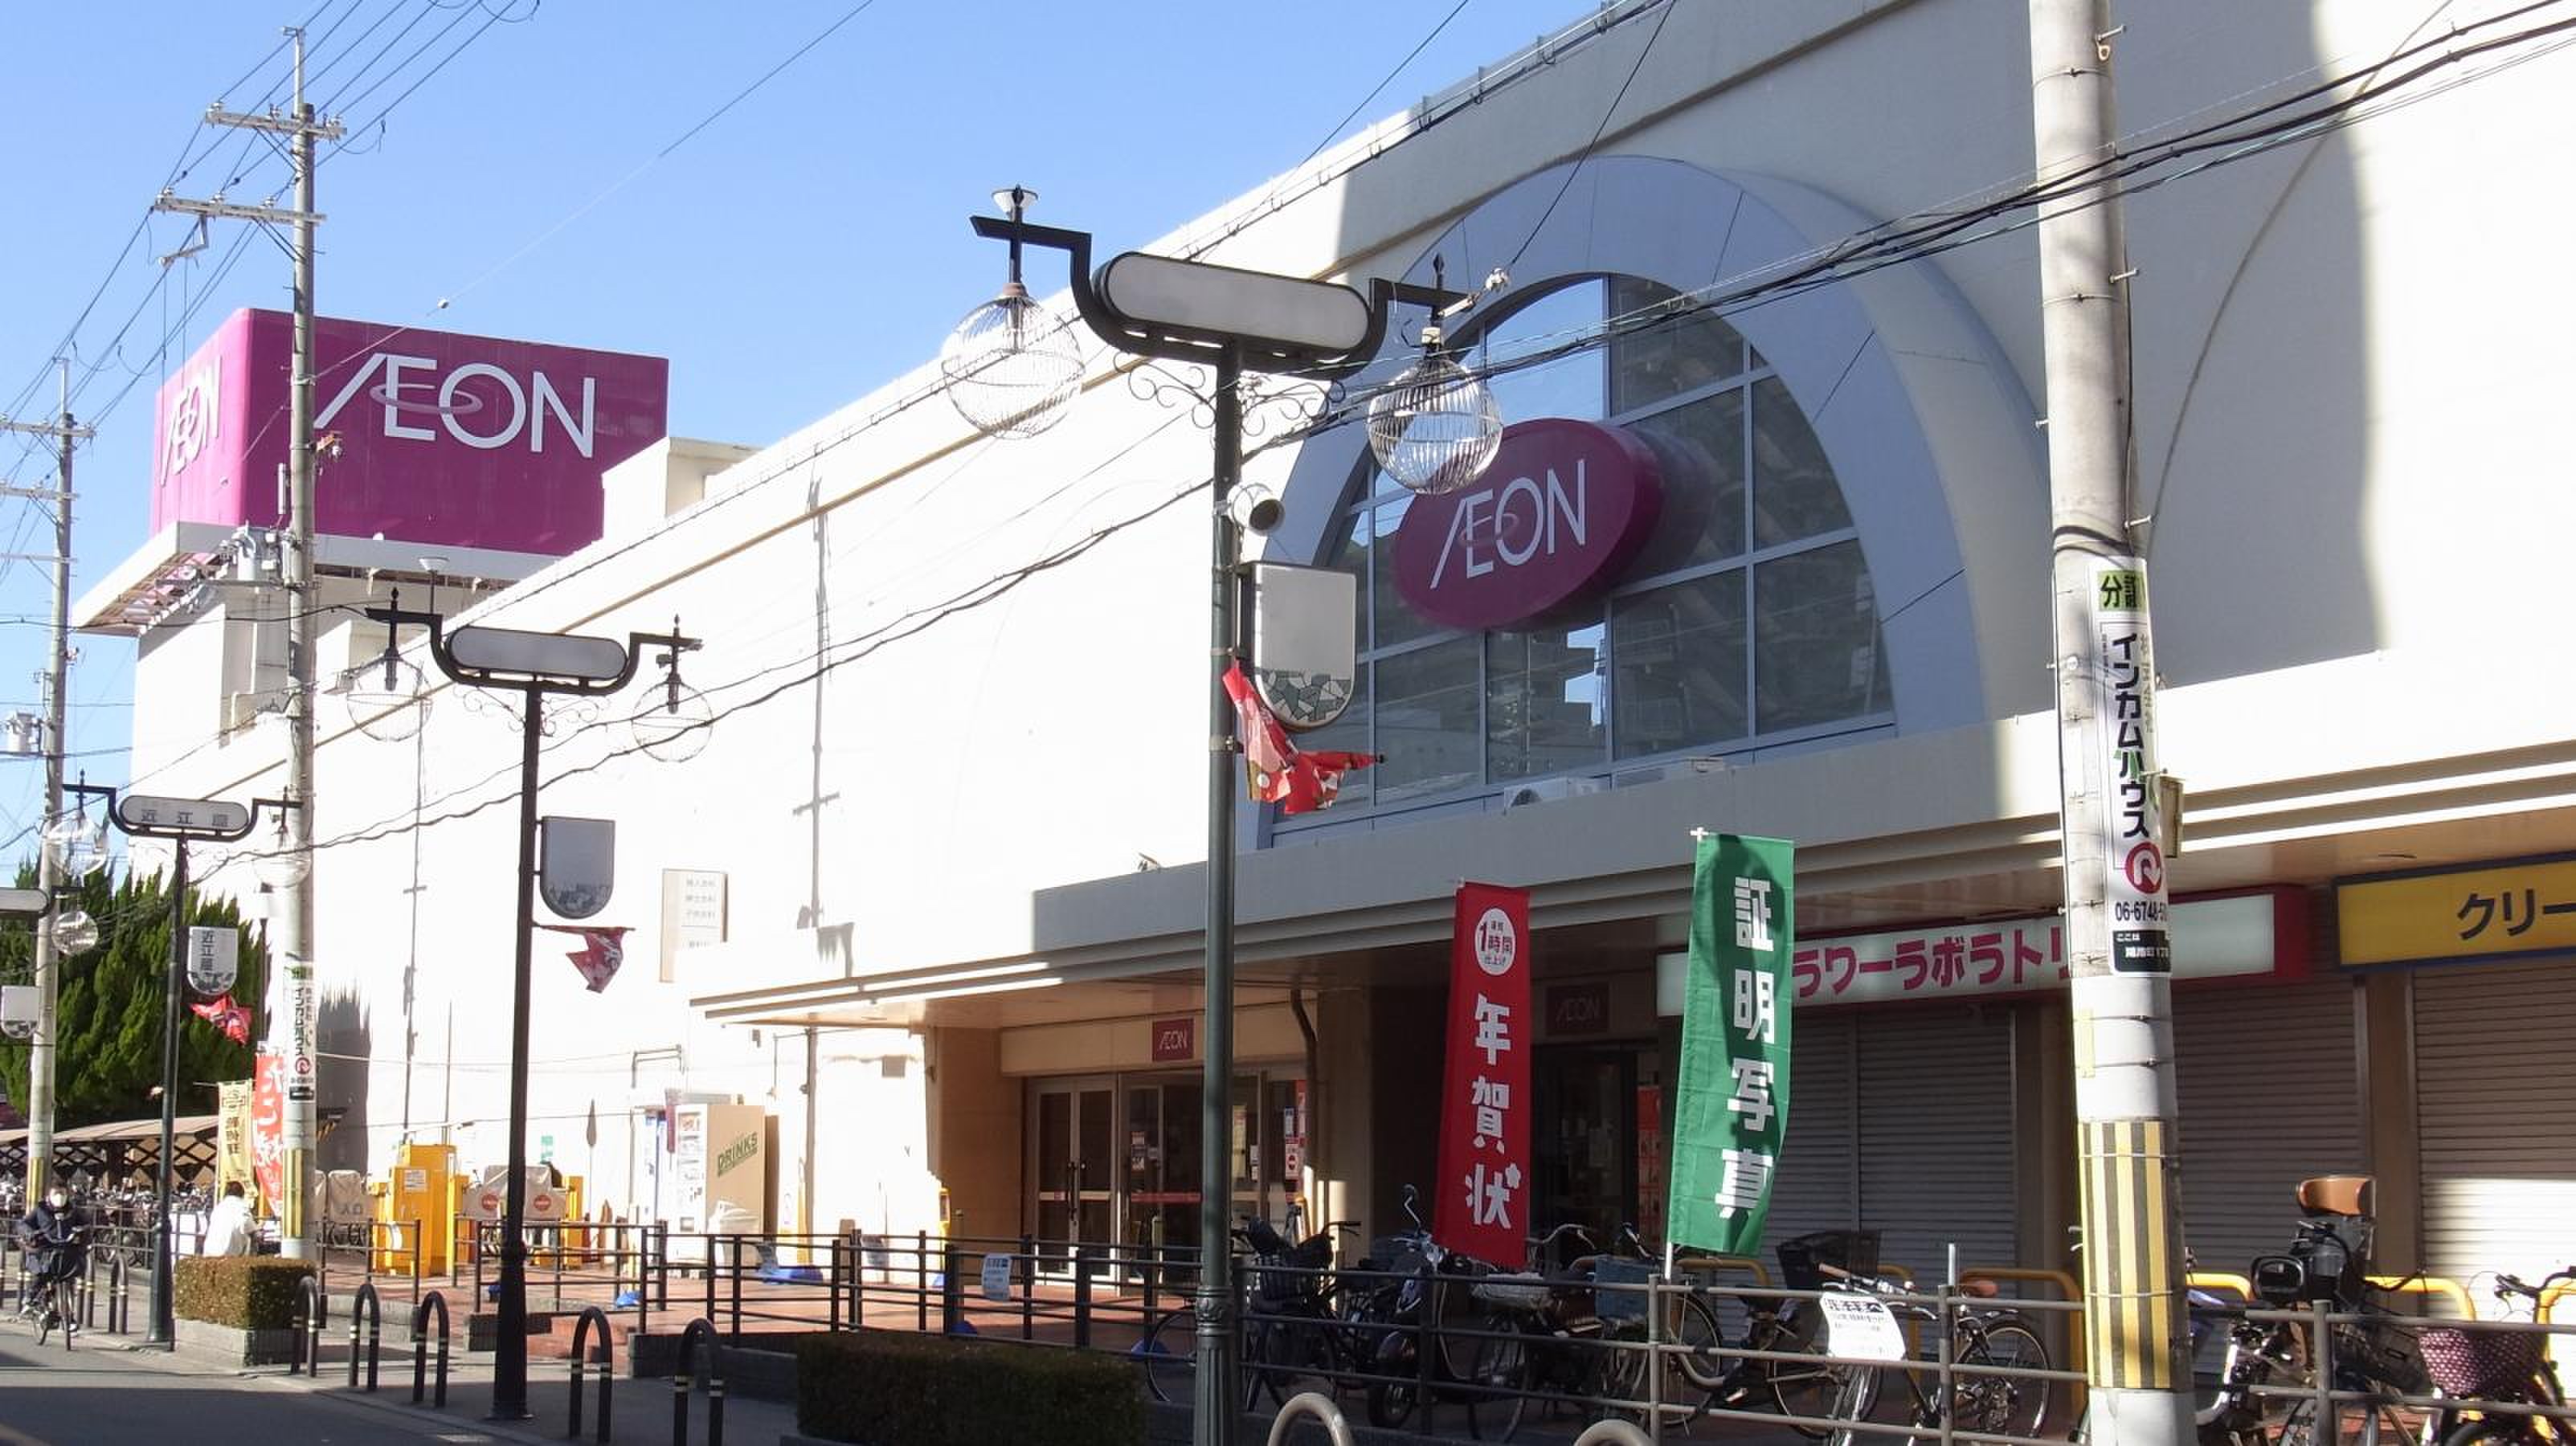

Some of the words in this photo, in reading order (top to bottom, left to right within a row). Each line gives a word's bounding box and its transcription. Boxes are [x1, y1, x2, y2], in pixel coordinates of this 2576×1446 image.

[2111, 631, 2150, 839] インカムハウス
[2456, 887, 2576, 941] クリー
[1464, 994, 1522, 1230] 年賀状
[1715, 876, 1774, 1219] 証明写真
[717, 1132, 759, 1178] DRINKS
